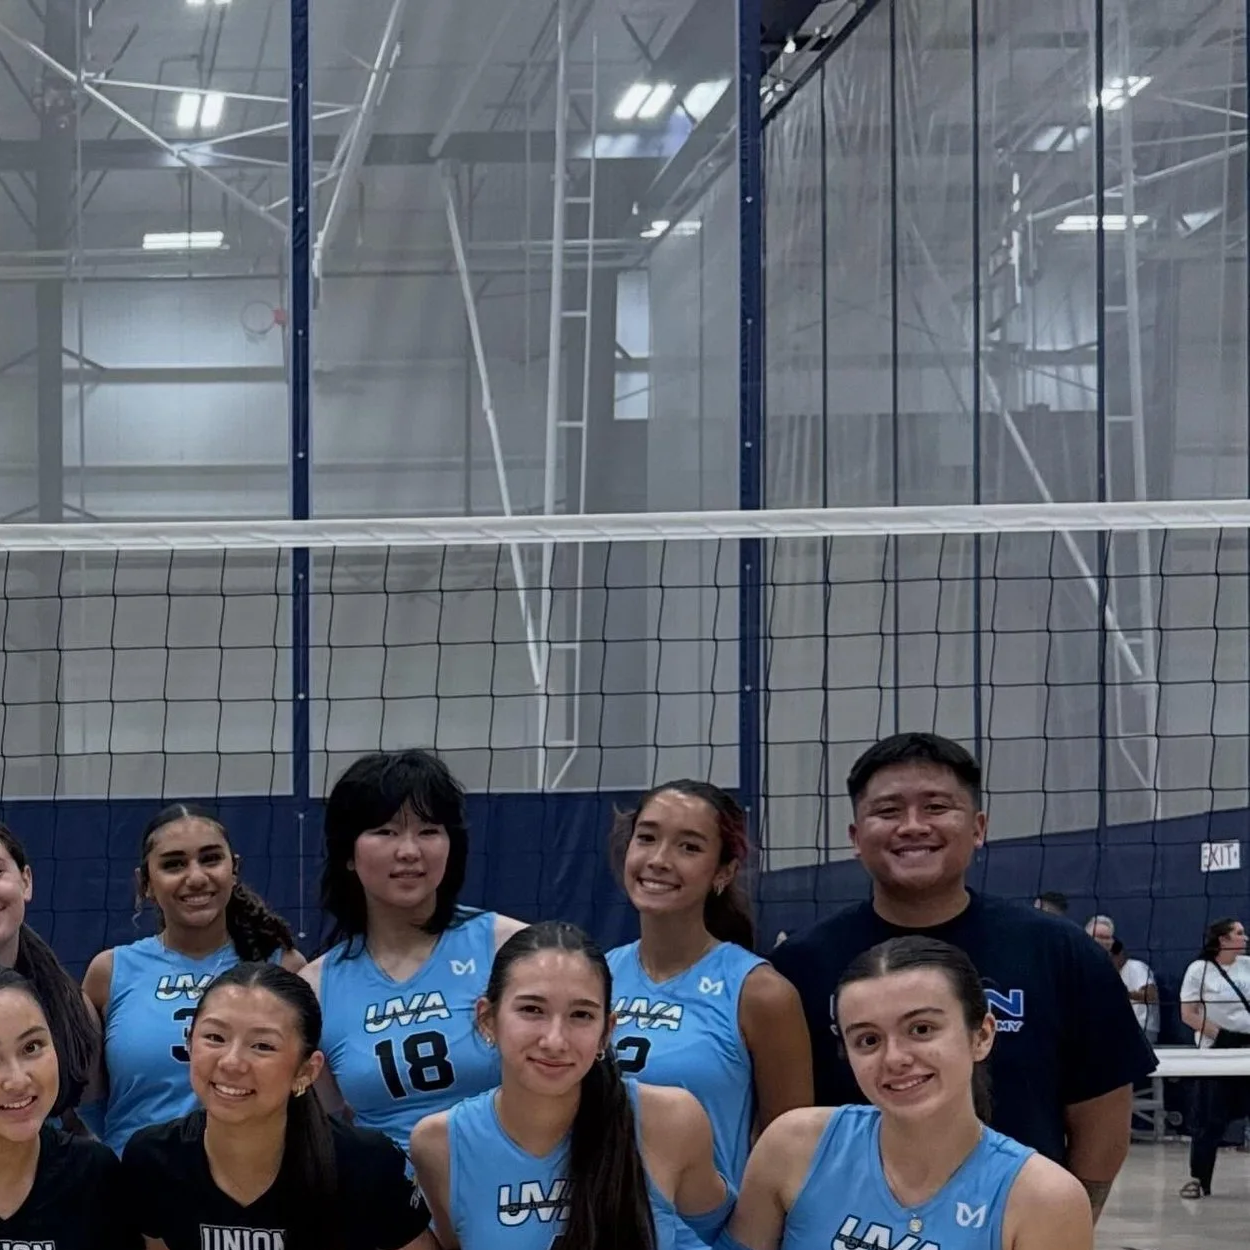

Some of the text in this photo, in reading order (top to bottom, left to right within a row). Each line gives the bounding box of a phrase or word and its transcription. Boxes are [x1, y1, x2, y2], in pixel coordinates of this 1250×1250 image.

[1202, 843, 1234, 868] EXIT
[155, 973, 214, 1000] UV
[364, 990, 452, 1033] UVA
[374, 1029, 456, 1101] 18
